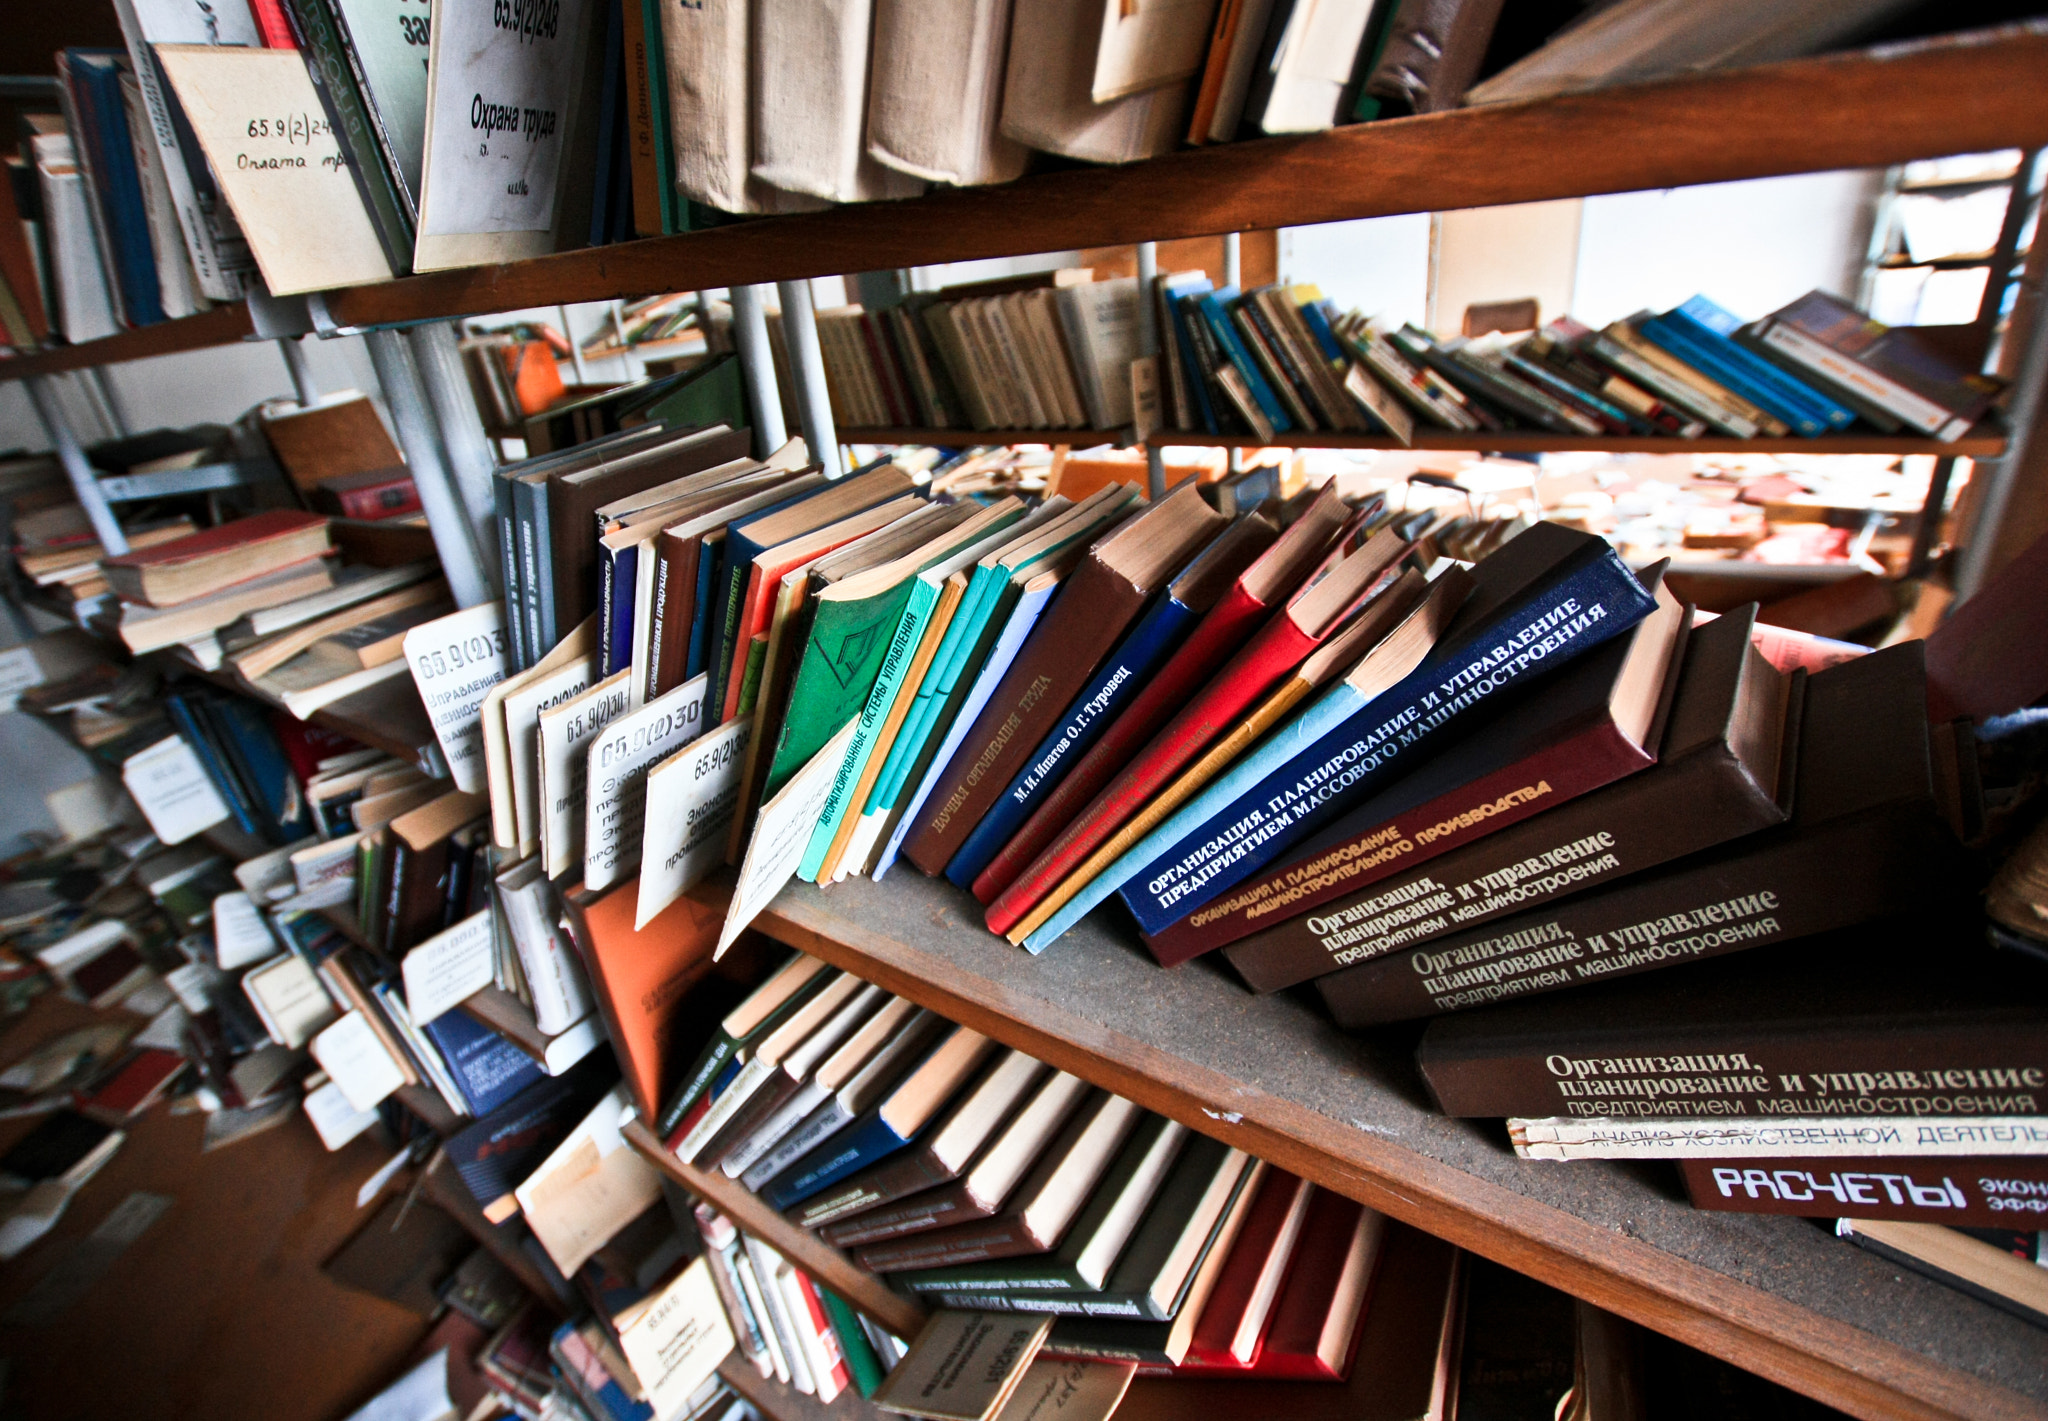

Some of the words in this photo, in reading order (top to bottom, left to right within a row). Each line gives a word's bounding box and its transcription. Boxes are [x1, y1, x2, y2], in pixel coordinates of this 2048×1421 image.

[247, 112, 334, 146] 65.9(2)24
[471, 93, 519, 138] Охрана
[523, 108, 556, 143] труда
[237, 153, 307, 170] Оплата
[654, 557, 669, 618] ПРОДУКЦИИ
[724, 565, 742, 638] ПРЕДПРИЯТИЕ
[816, 729, 868, 827] АВТОМАТИЗИРОВАННЫЕ
[859, 681, 889, 729] СИСТЕМЫ
[879, 611, 919, 682] УПРАВЛЕНИЯ
[966, 713, 1022, 786] ОРГАНИЗАЦИЯ
[1018, 674, 1052, 712] ТРУДА
[1036, 738, 1071, 779] Ипатов
[1083, 665, 1133, 717] Туровец
[1149, 808, 1271, 895] ОРГАНИЗАЦИЯ.
[1268, 706, 1422, 813] ПЛАНИРОВАНИЕ
[1421, 692, 1442, 711] И
[1440, 597, 1582, 696] УПРАВЛЕНИЕ
[1157, 812, 1294, 909] ПРЕДПРИЯТИЕМ
[1291, 742, 1398, 819] МАССОВОГО
[1398, 603, 1607, 747] МАШИНОСТРОЕНИЯ
[1190, 883, 1277, 928] ОРГАНИЗАЦИЯ
[1274, 877, 1286, 893] И
[1287, 825, 1401, 885] ПЛАНИРОВАНИЕ
[1246, 839, 1414, 919] МАШИНОСТРОИТЕЛЬНОГО
[1415, 780, 1553, 846] ПРОИЗВОДСТВА
[1306, 875, 1447, 936] Организация,
[1321, 889, 1456, 953] планирование
[1459, 882, 1477, 902] и
[1474, 828, 1616, 895] управление
[1334, 916, 1448, 965] предприятием
[1452, 853, 1620, 922] машиностроения
[1411, 921, 1575, 976] Организация,
[1422, 941, 1584, 995] планирование
[1585, 934, 1610, 954] и
[1611, 890, 1780, 953] управление
[1434, 968, 1571, 1011] предприятием
[1576, 917, 1782, 978] машиностроения
[1546, 1053, 1764, 1079] Организация,
[1557, 1075, 1771, 1099] планирование
[1779, 1073, 1806, 1092] и
[1809, 1067, 2046, 1096] управление
[1568, 1099, 1747, 1117] предприятием
[1756, 1095, 2038, 1116] машиностроения
[1591, 1130, 1675, 1148] АНАЛИЗ
[1712, 1167, 1967, 1209] РАСЧЕТЫ
